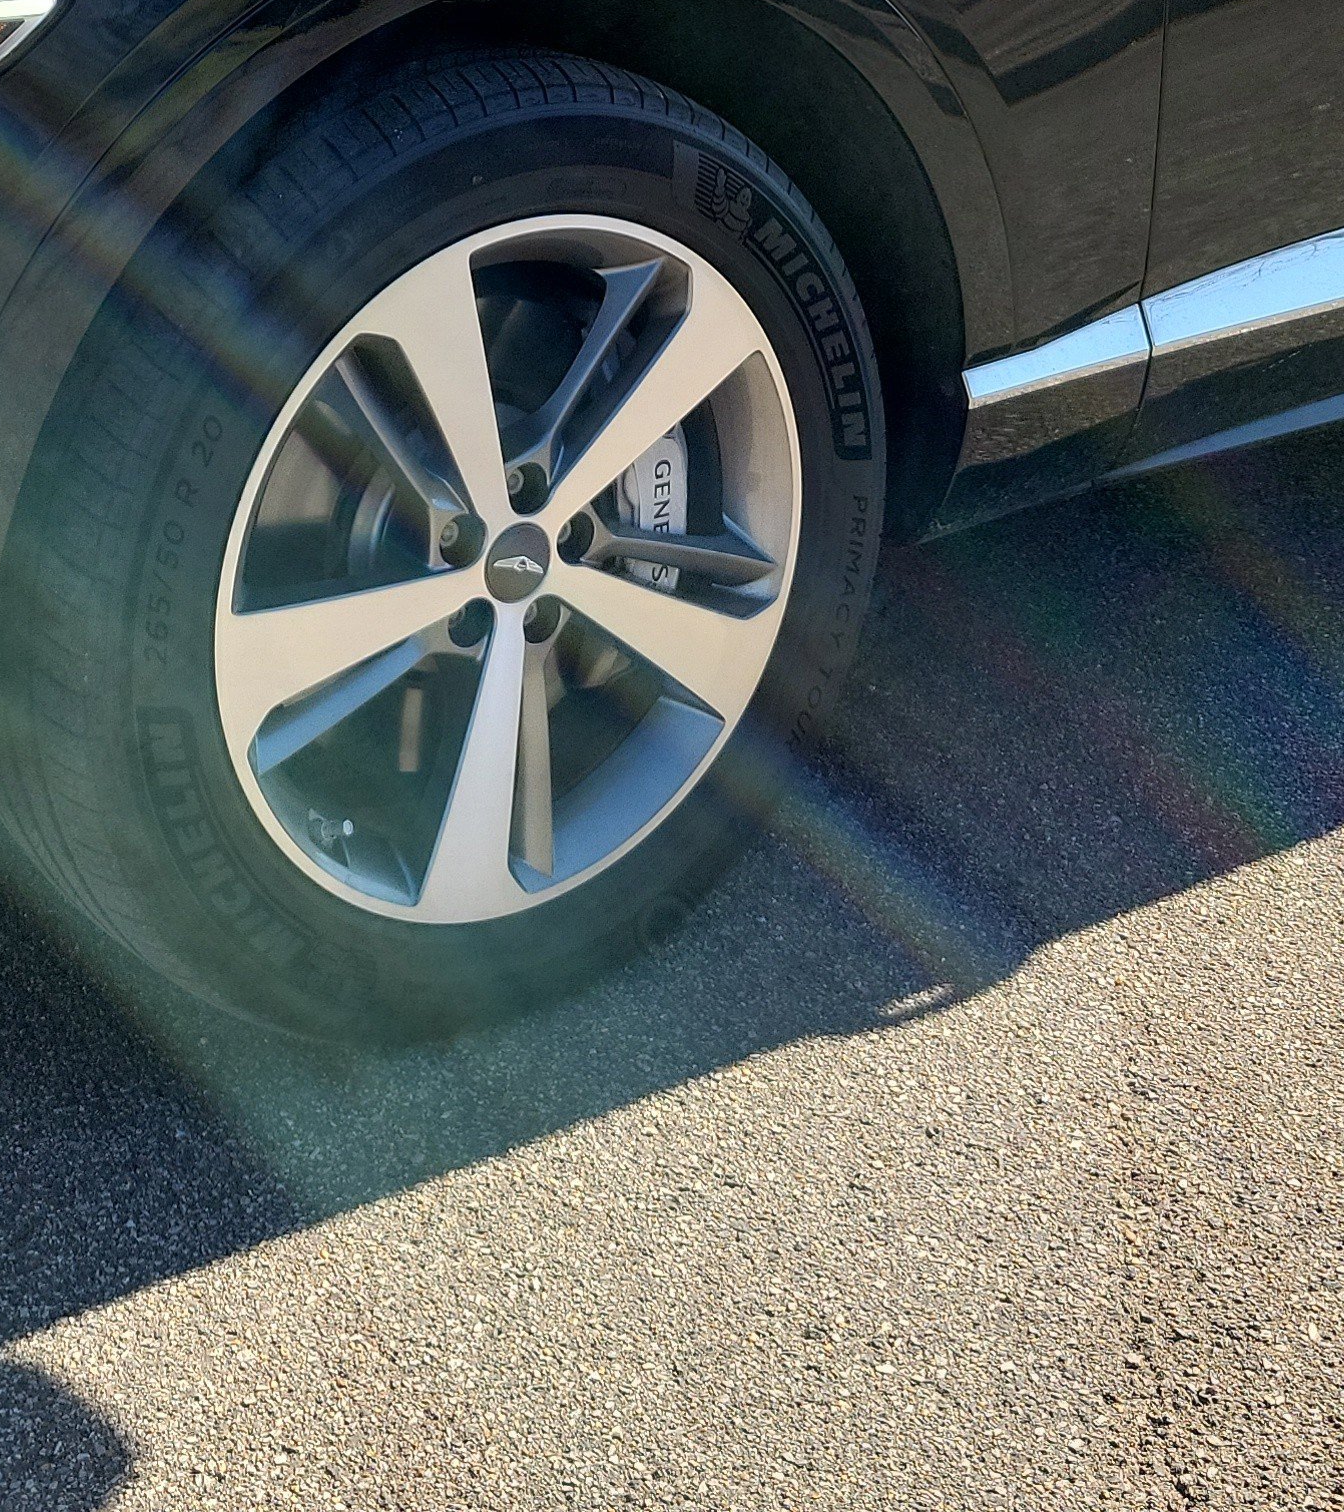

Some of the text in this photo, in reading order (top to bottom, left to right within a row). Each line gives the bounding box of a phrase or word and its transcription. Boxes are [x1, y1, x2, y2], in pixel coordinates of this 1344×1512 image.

[753, 216, 868, 448] MICHELIN
[142, 413, 225, 665] 265/50 R 20
[651, 459, 673, 583] GENES
[829, 494, 869, 651] PRIMACY
[146, 722, 306, 967] MICHELIN
